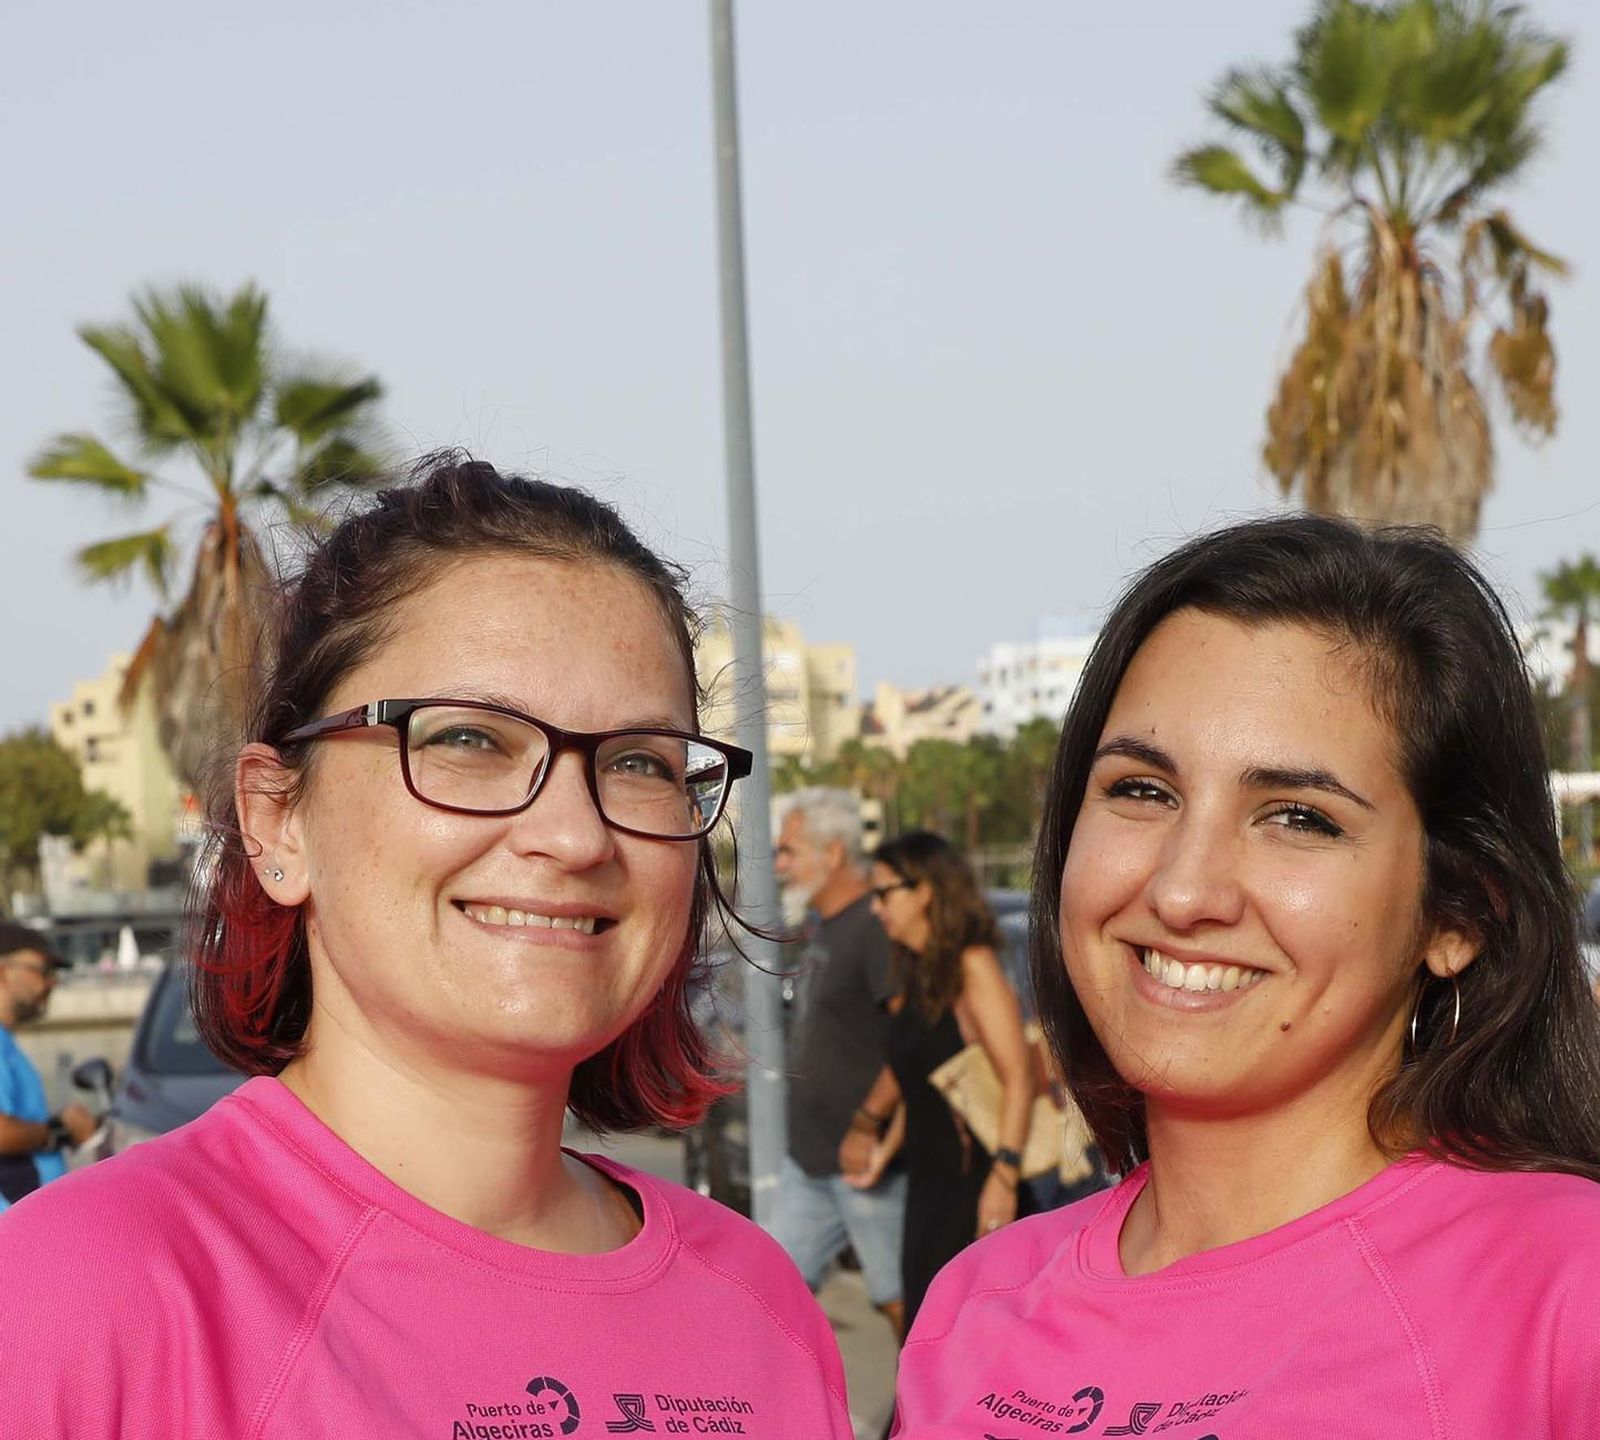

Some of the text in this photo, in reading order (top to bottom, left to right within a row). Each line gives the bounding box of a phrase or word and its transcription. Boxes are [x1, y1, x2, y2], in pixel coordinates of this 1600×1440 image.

[466, 1400, 546, 1418] Puerto de
[654, 1394, 754, 1415] Diputación
[977, 1392, 1064, 1434] Algeciras
[1012, 1389, 1074, 1418] Puerto de
[665, 1415, 746, 1434] de Cádiz
